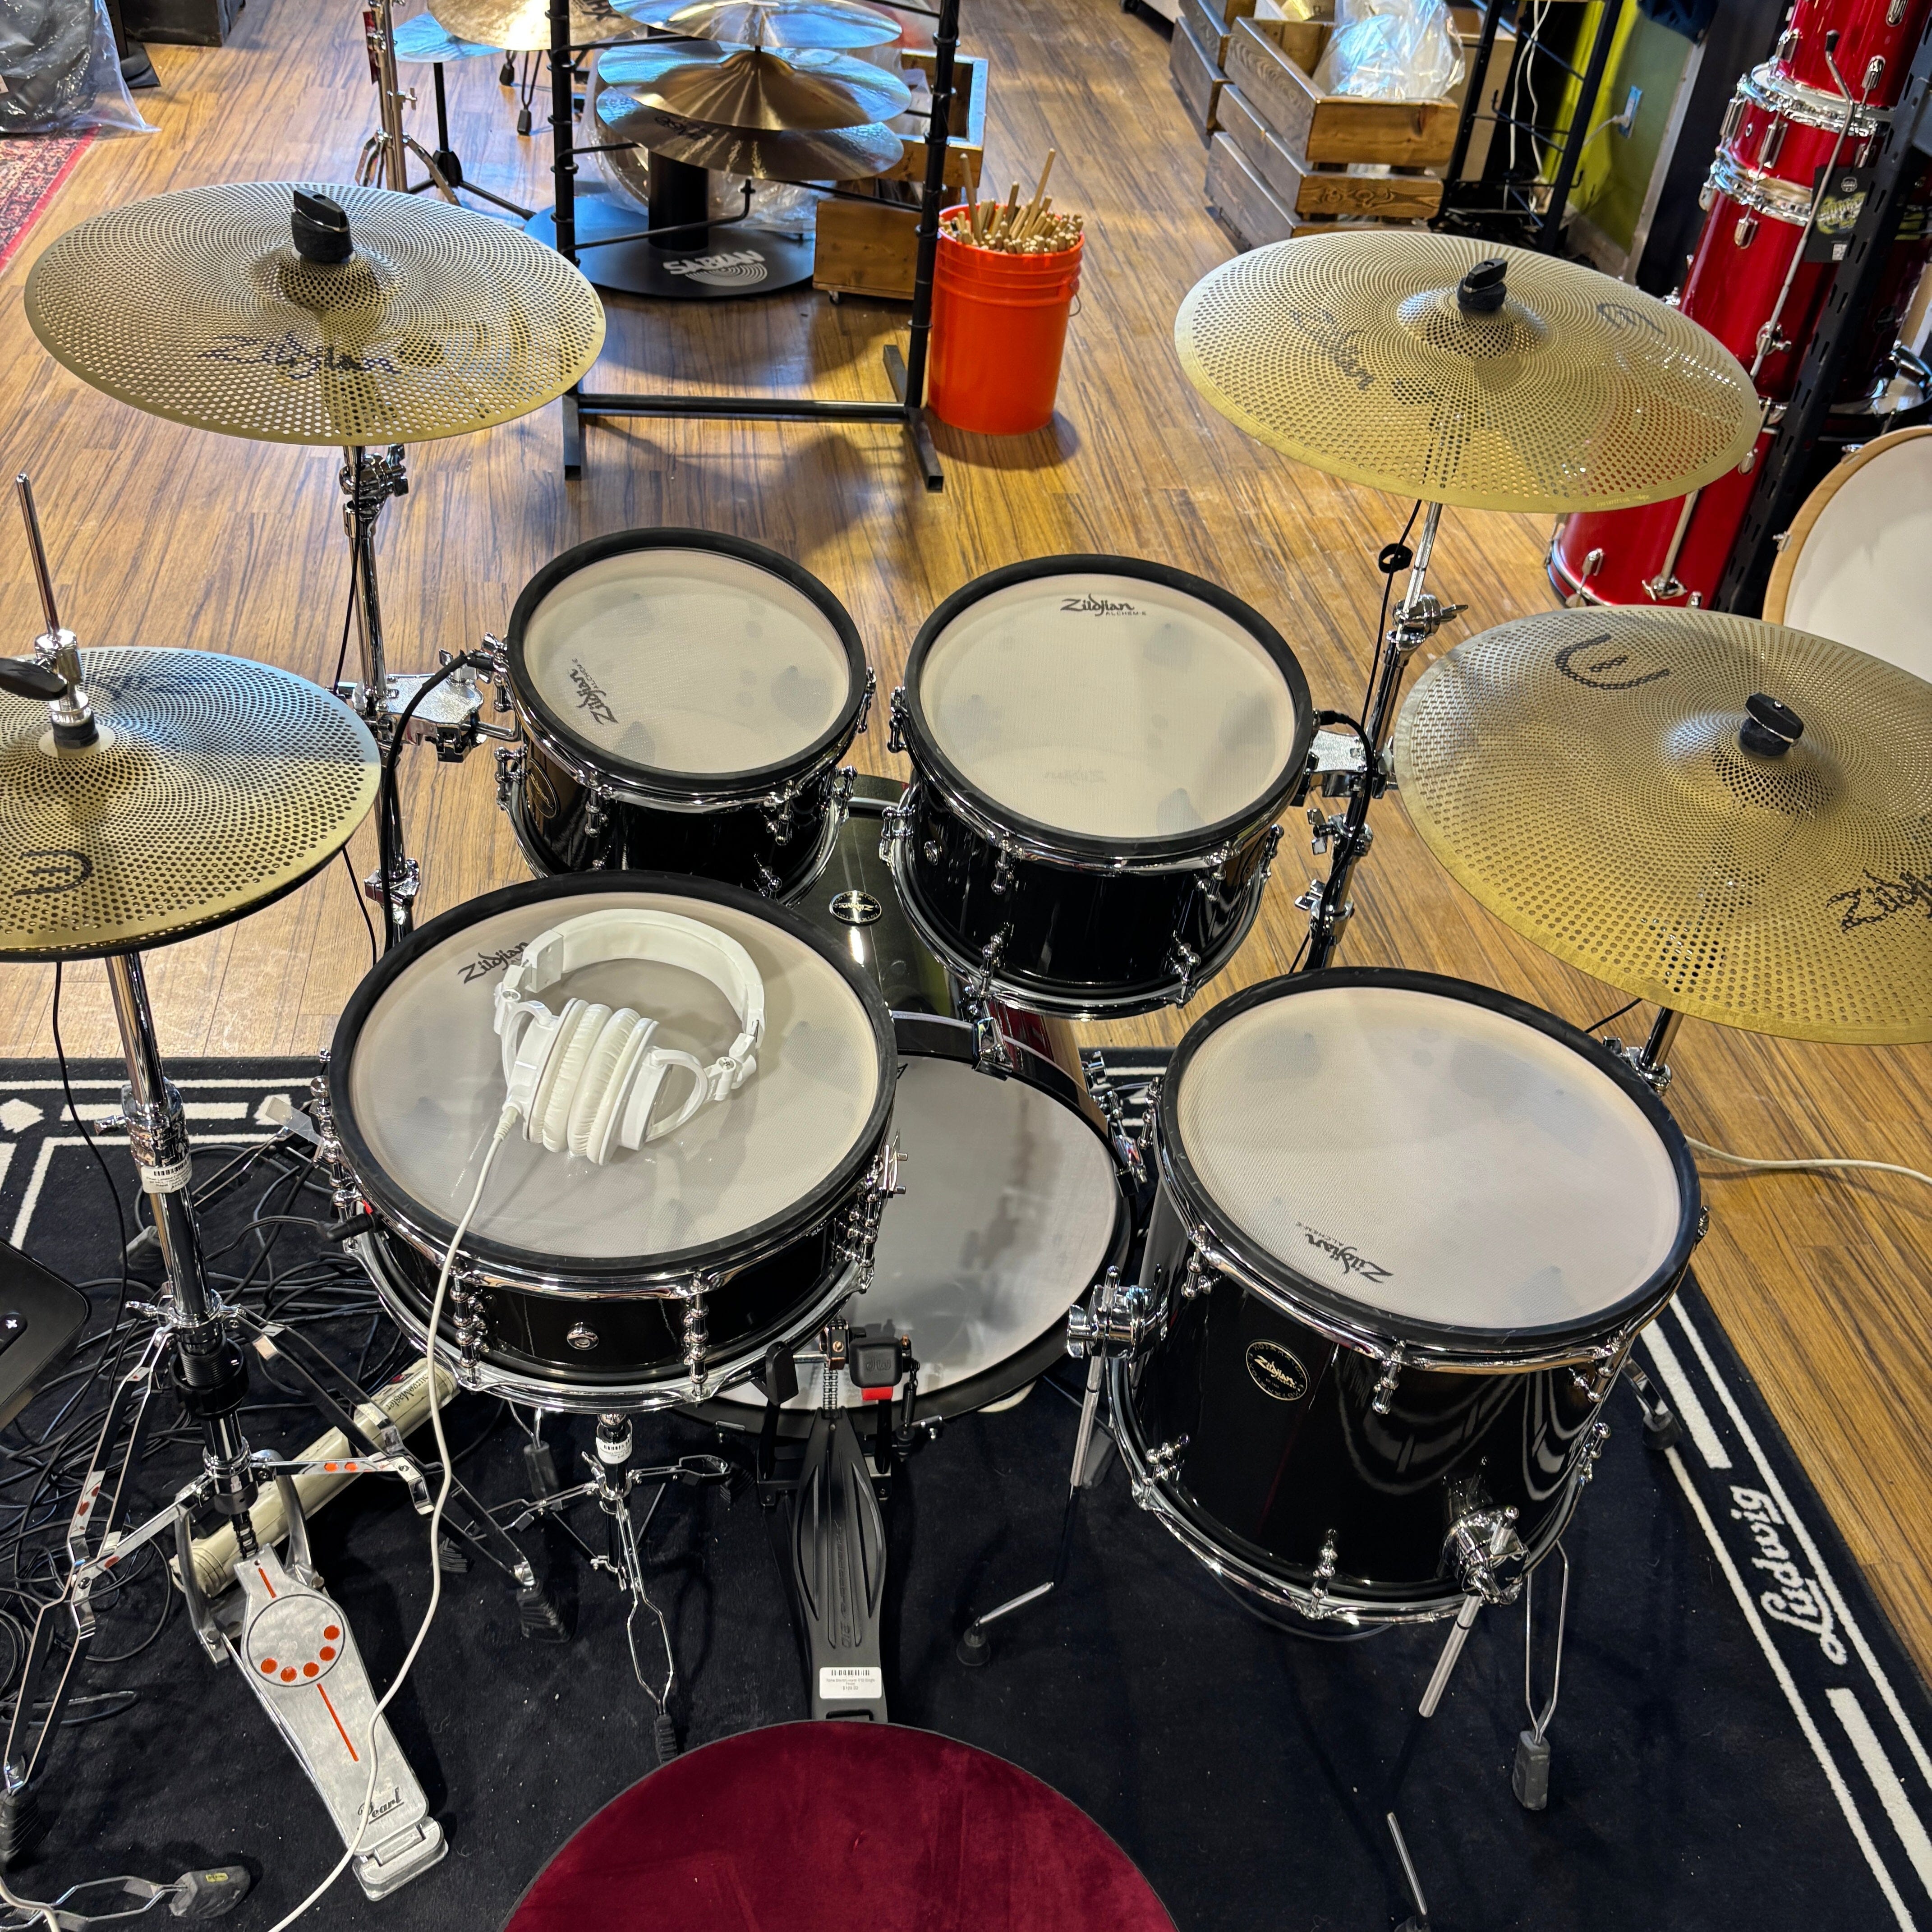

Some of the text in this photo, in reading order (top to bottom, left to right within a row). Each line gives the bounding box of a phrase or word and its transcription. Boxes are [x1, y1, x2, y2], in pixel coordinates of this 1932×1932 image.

[663, 250, 765, 275] SABIAN
[1060, 593, 1135, 616] Zildjian
[570, 668, 619, 726] Zildjian
[457, 942, 529, 984] Zildjian
[1305, 1233, 1394, 1283] Zildjian
[866, 1357, 892, 1371] dw
[1254, 1355, 1296, 1386] Zildjian
[1730, 1486, 1848, 1665] Ludwig
[358, 1786, 402, 1818] Pearl
